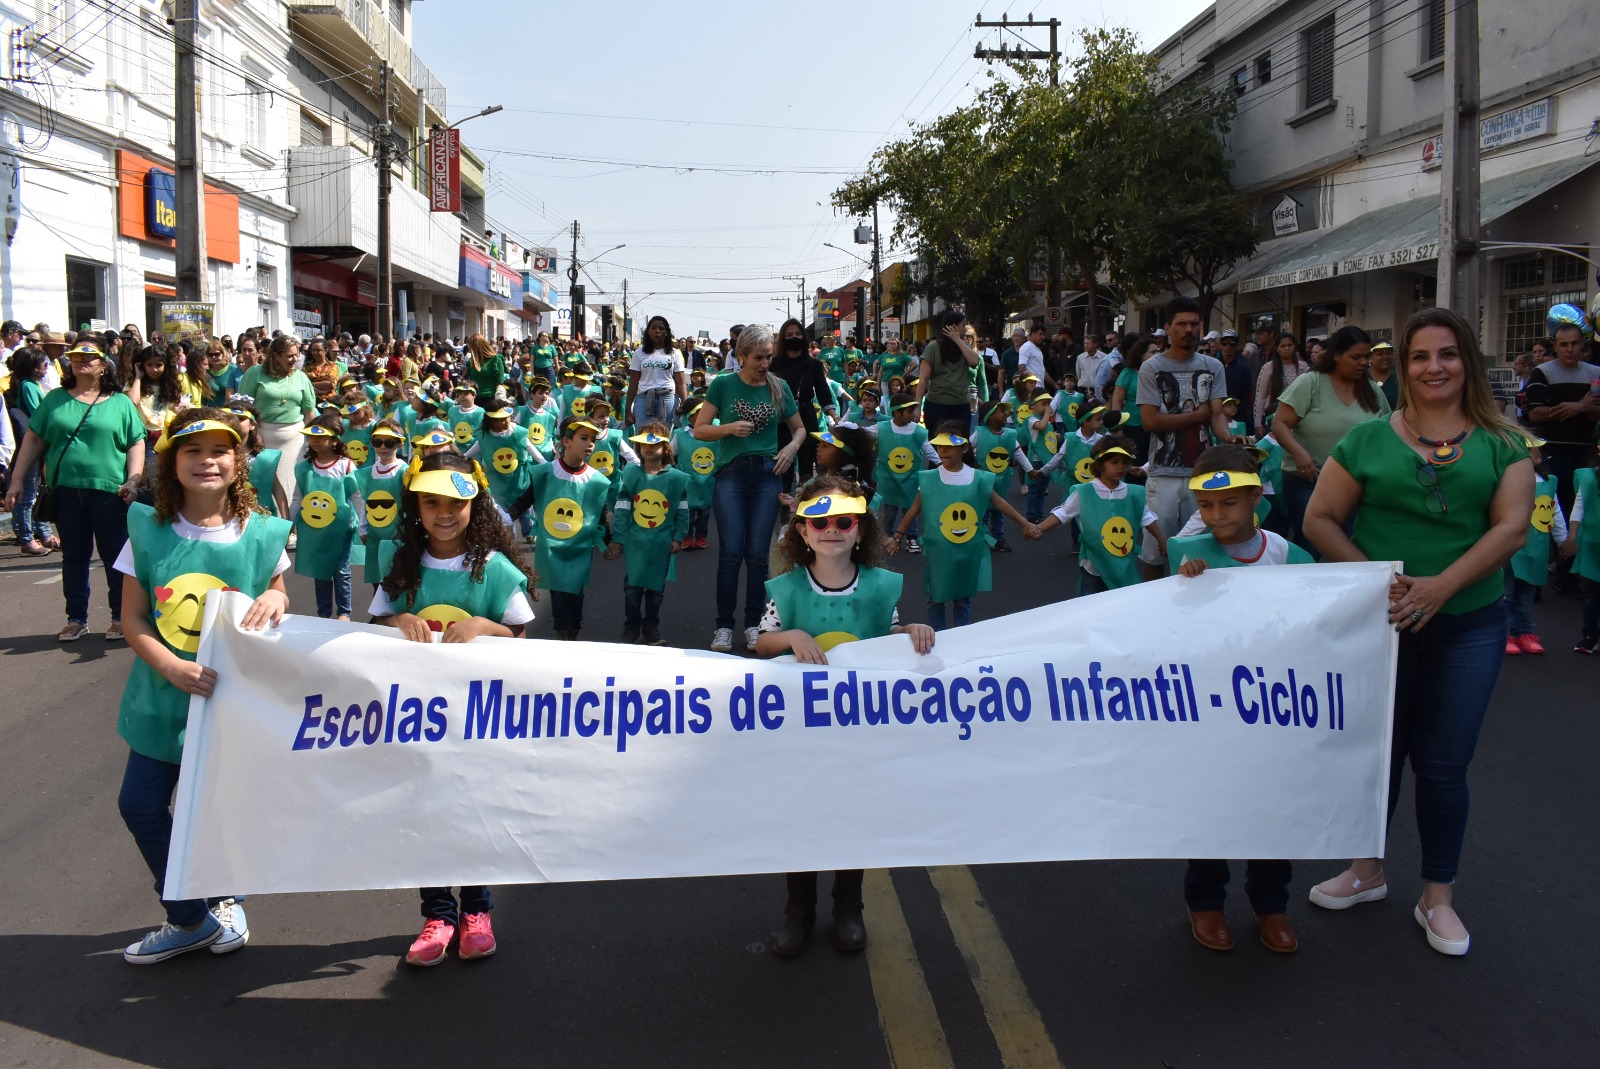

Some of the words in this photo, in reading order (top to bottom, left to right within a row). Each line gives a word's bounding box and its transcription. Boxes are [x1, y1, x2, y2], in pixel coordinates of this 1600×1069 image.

[1484, 129, 1513, 145] EXPEDIENTE
[1524, 121, 1541, 132] GERAL
[435, 130, 447, 210] AMERICANAS
[1274, 206, 1294, 220] Visão
[292, 684, 447, 751] Escolas
[464, 676, 712, 752] Municipais
[729, 673, 785, 732] de
[803, 665, 1032, 741] Educação
[1044, 662, 1199, 722] Infantil
[1210, 694, 1223, 708] -
[1232, 664, 1318, 729] Ciclo
[1326, 671, 1344, 731] II
